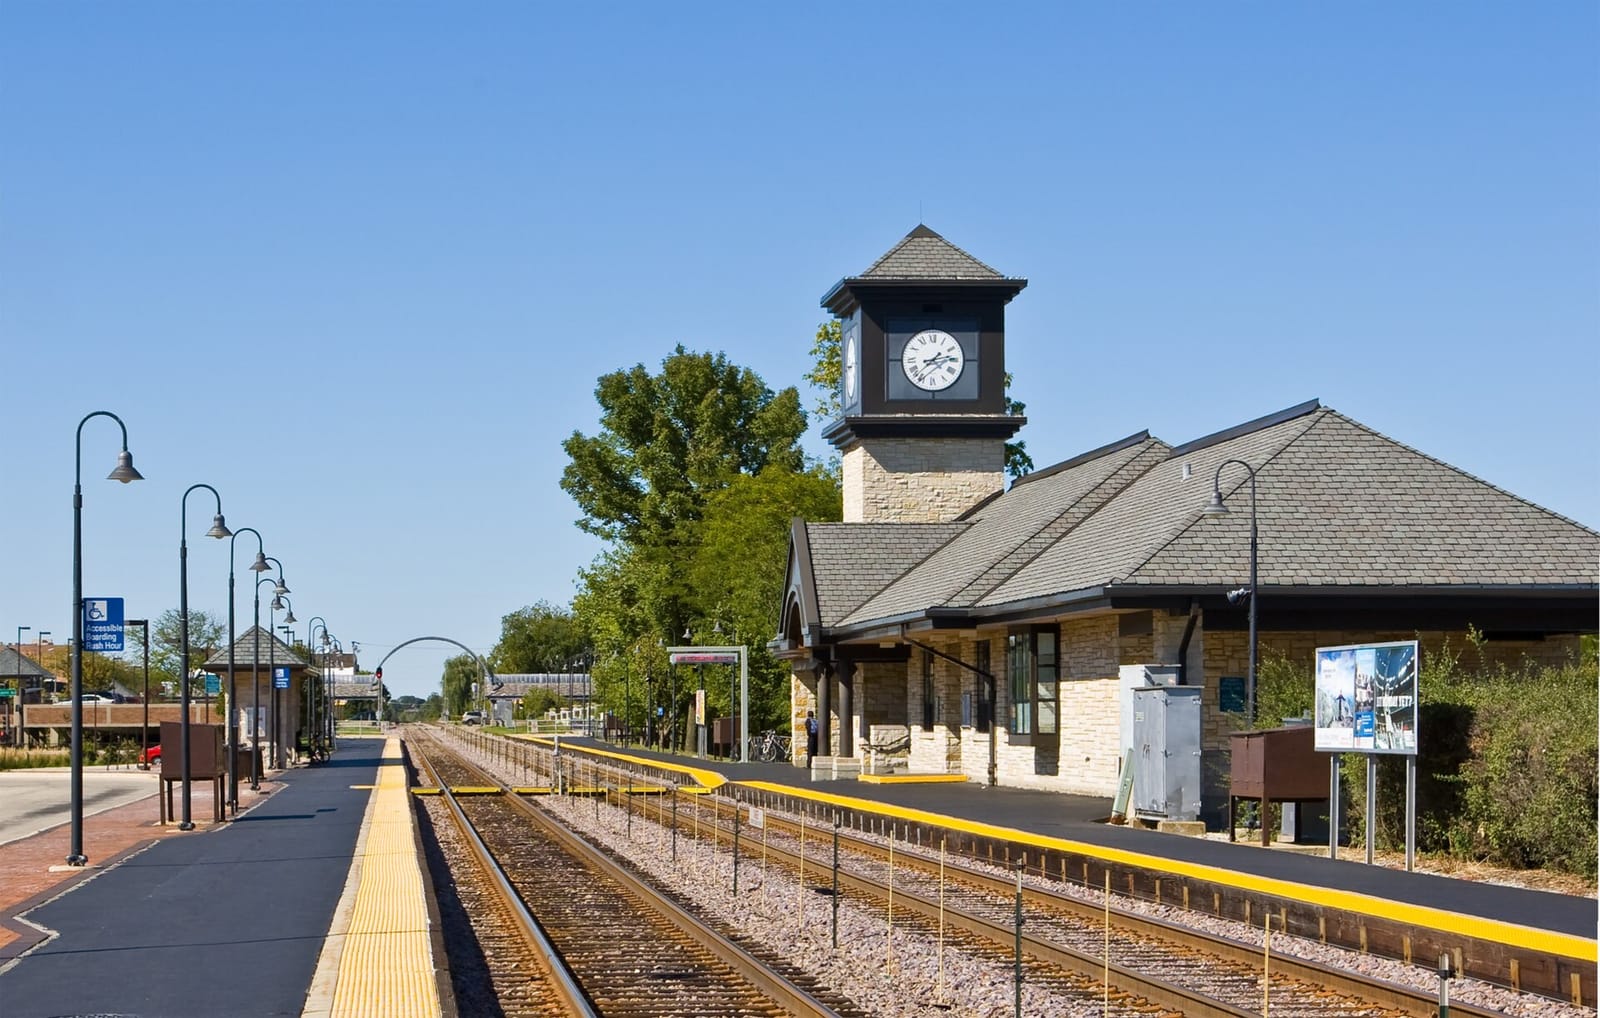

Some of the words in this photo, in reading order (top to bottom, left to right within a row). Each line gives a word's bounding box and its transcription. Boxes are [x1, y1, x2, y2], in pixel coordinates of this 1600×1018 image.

[86, 624, 123, 632] Accessible
[86, 633, 117, 642] Boarding
[86, 641, 104, 650] Rush
[104, 641, 122, 650] Hour
